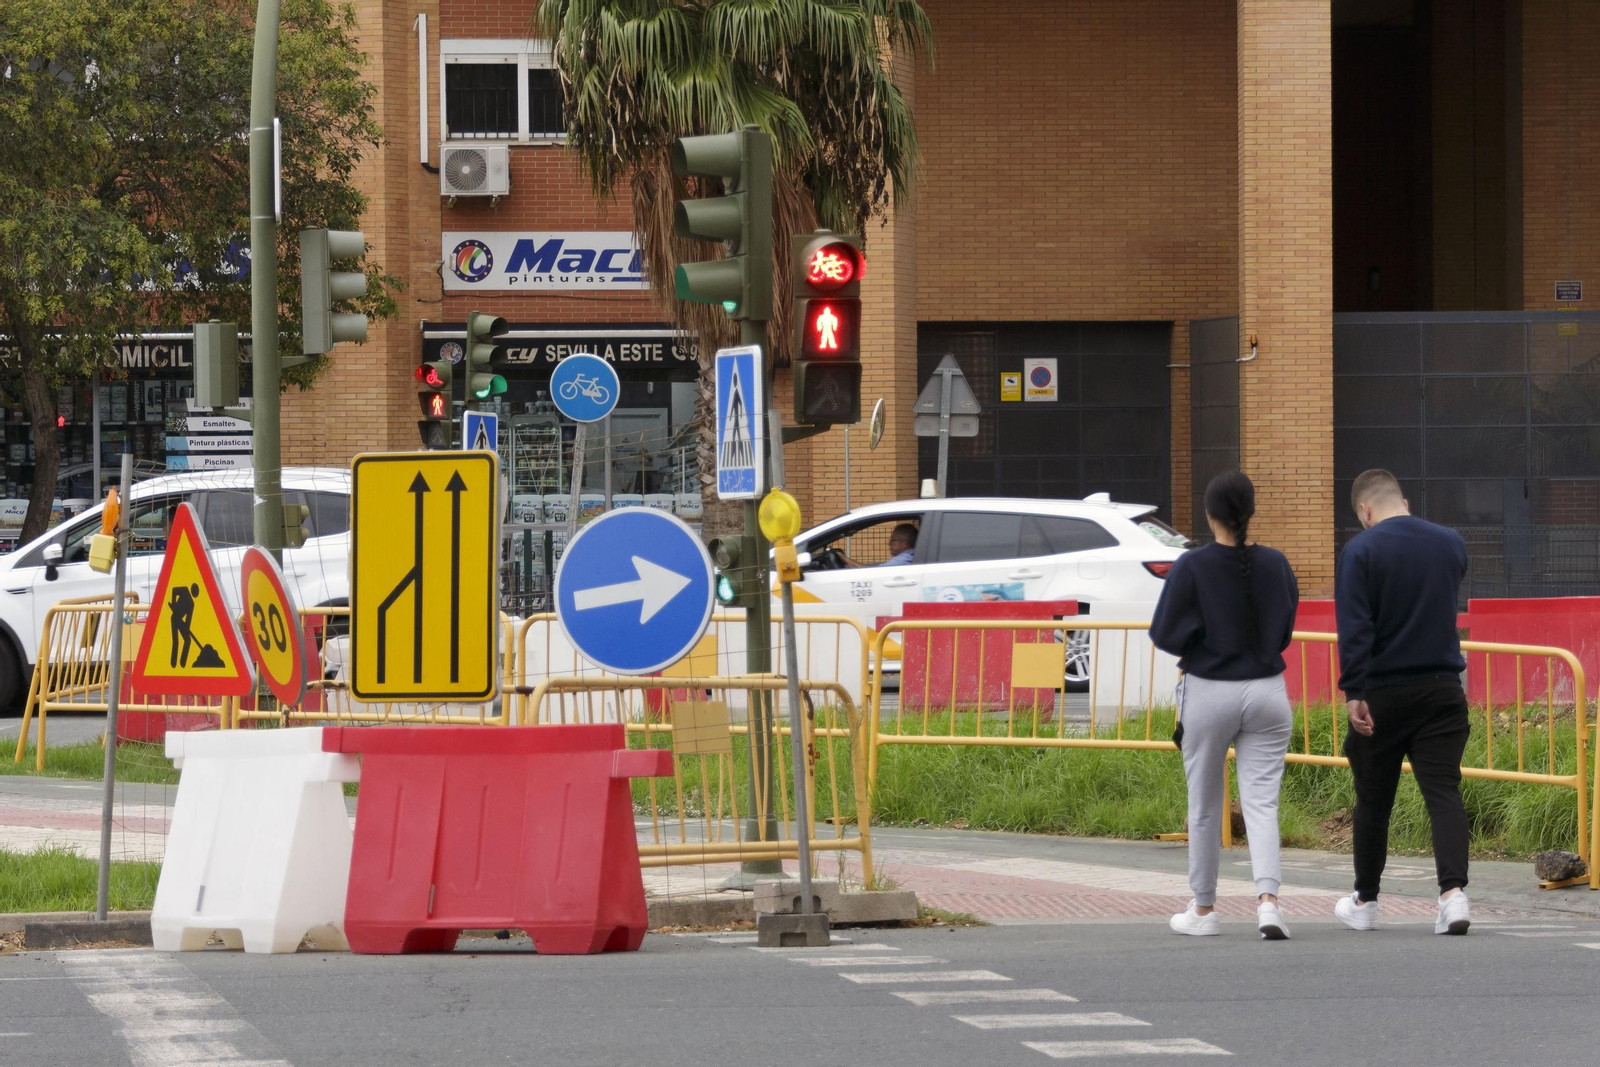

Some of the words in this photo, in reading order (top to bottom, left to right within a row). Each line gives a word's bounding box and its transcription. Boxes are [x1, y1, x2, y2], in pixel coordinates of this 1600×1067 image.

[509, 274, 606, 285] pinturas
[620, 344, 663, 361] ESTE
[217, 439, 250, 447] plásticas
[850, 581, 873, 589] TAXI
[253, 602, 287, 653] 30
